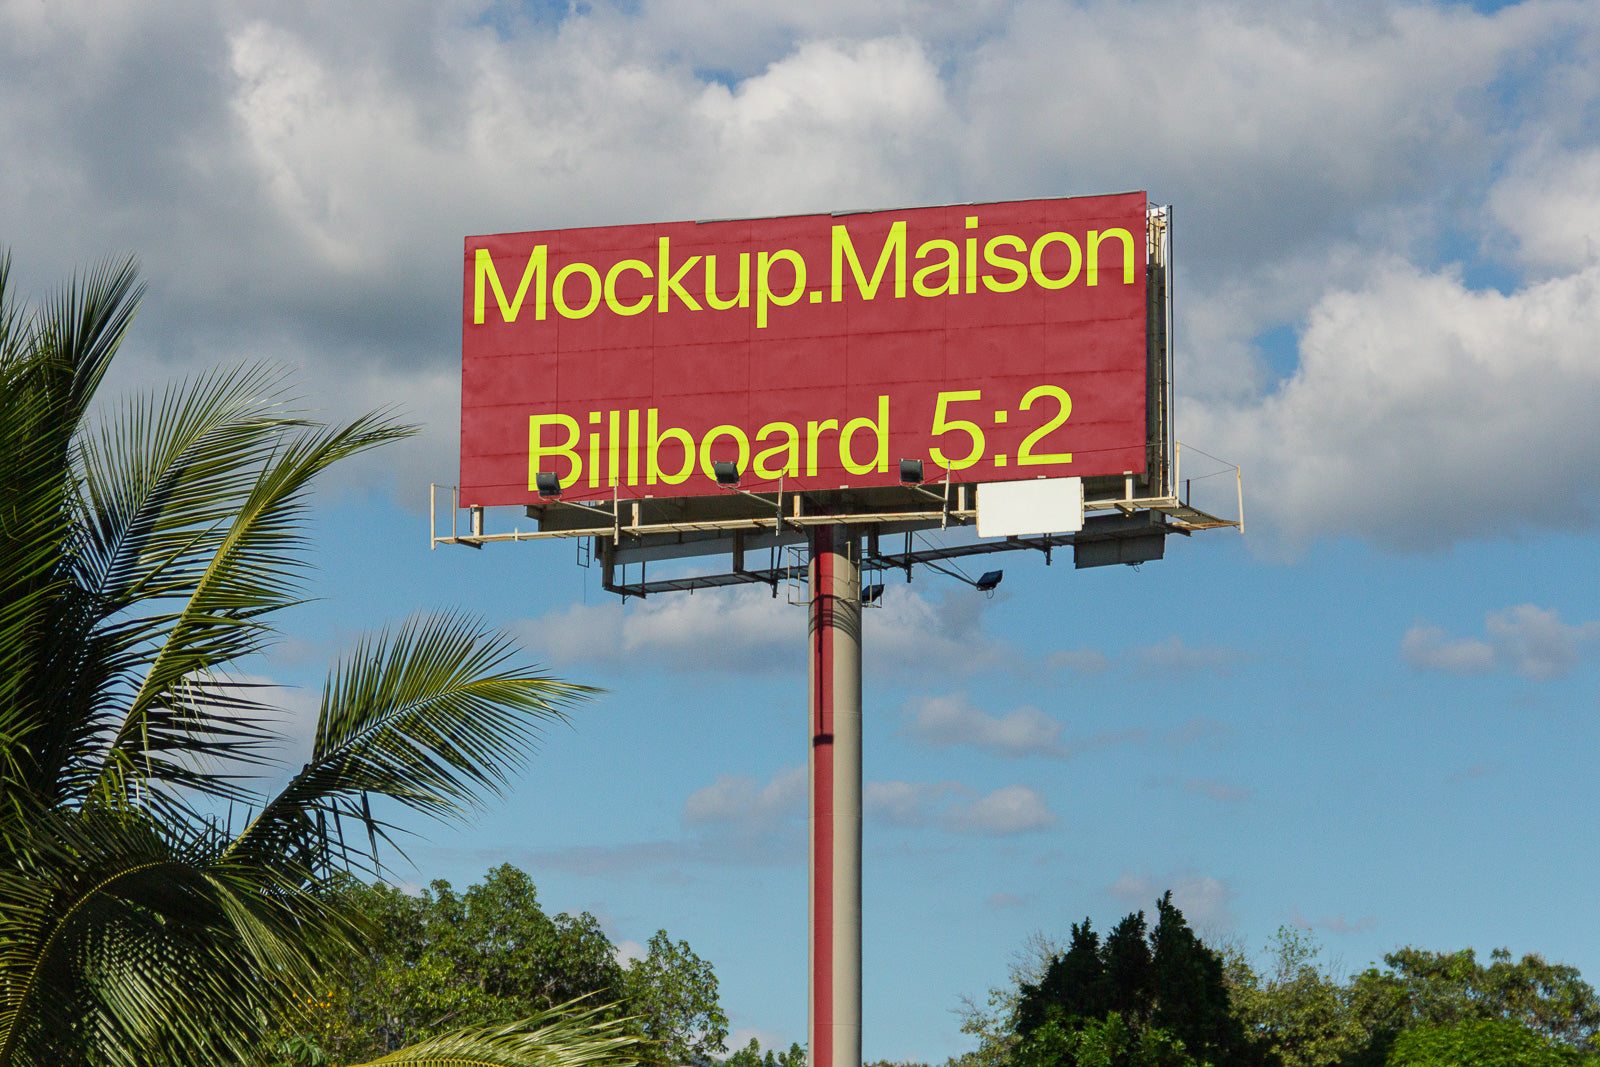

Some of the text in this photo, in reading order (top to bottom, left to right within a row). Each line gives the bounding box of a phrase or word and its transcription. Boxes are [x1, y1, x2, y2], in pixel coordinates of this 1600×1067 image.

[473, 215, 1135, 329] Mockup.Maison
[527, 384, 1073, 492] Billboard 5:2
